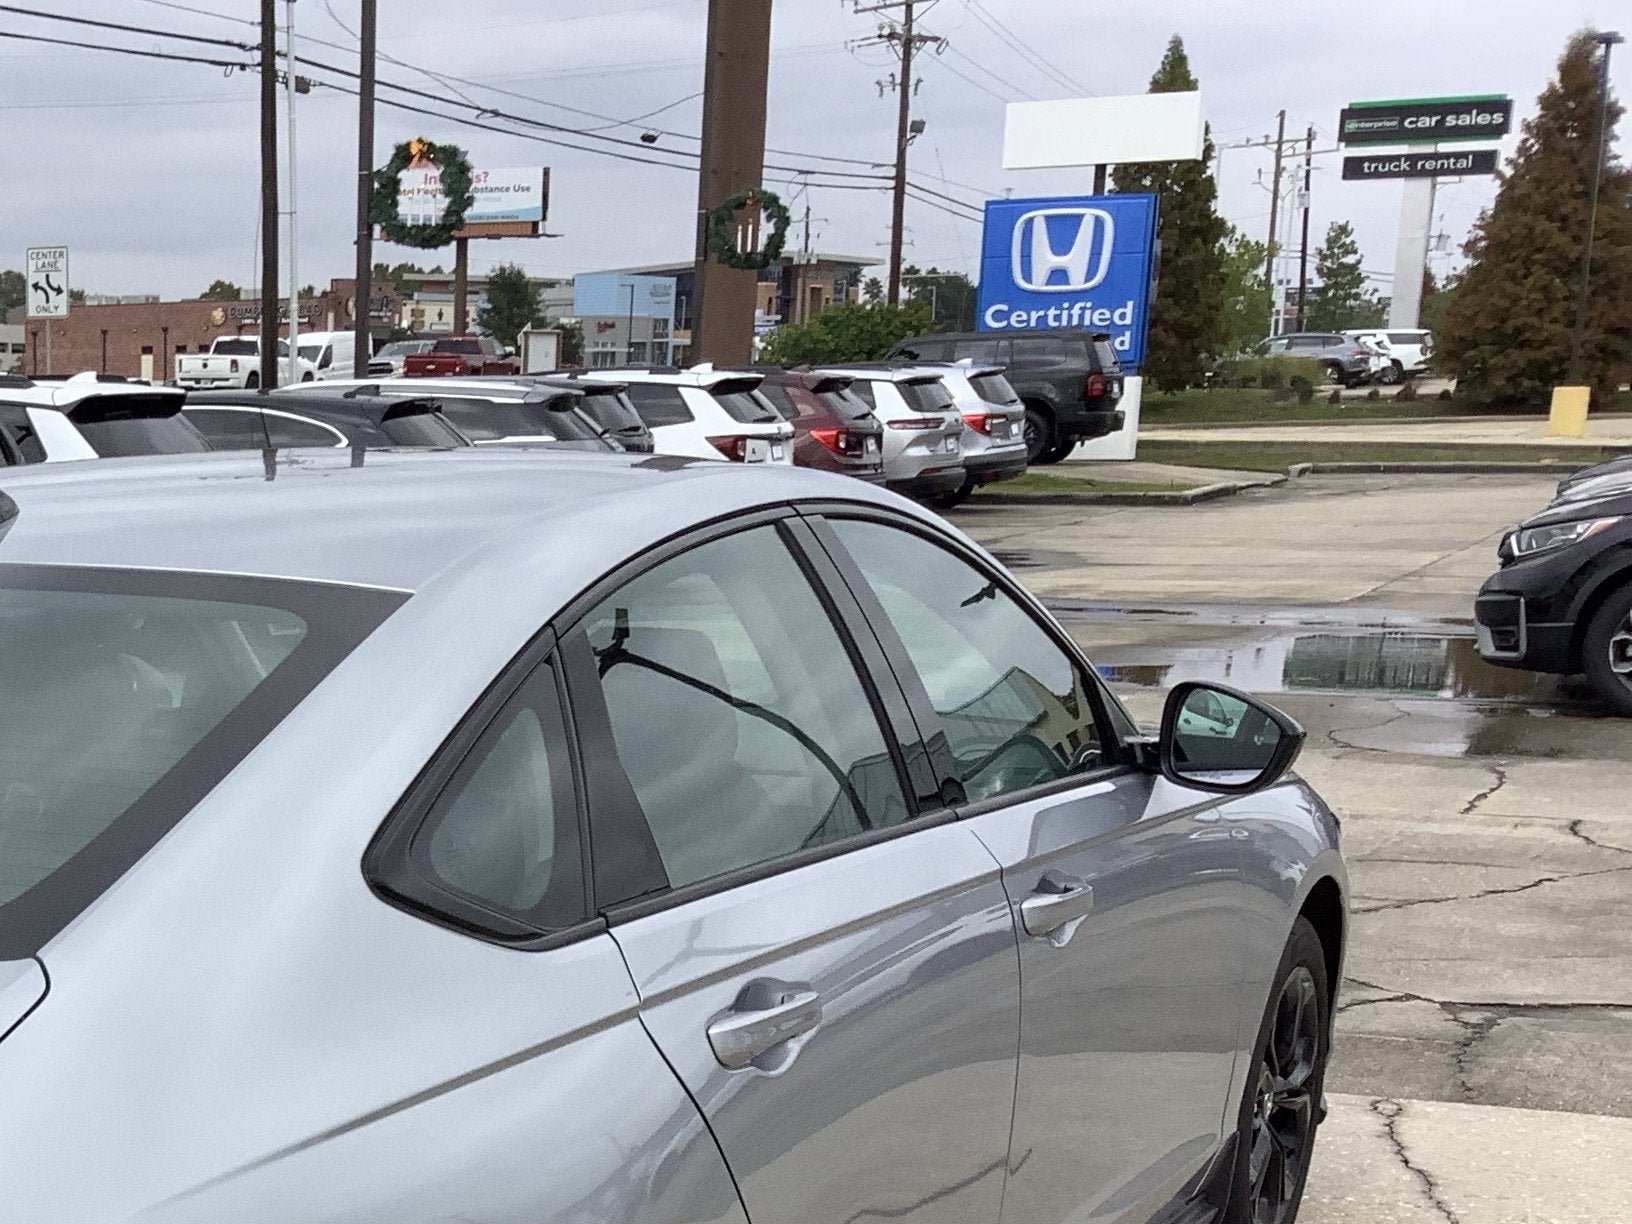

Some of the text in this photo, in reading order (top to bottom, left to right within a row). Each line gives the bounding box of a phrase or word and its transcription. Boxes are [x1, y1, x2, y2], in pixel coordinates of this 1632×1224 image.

[1404, 114, 1441, 129] car
[1445, 109, 1505, 127] sales
[1363, 155, 1473, 173] truck rental
[513, 184, 531, 193] Use
[30, 250, 65, 261] CENTER
[35, 261, 60, 270] LANE
[35, 304, 60, 314] ONLY
[229, 304, 286, 319] DUMPG
[984, 300, 1135, 329] Certified
